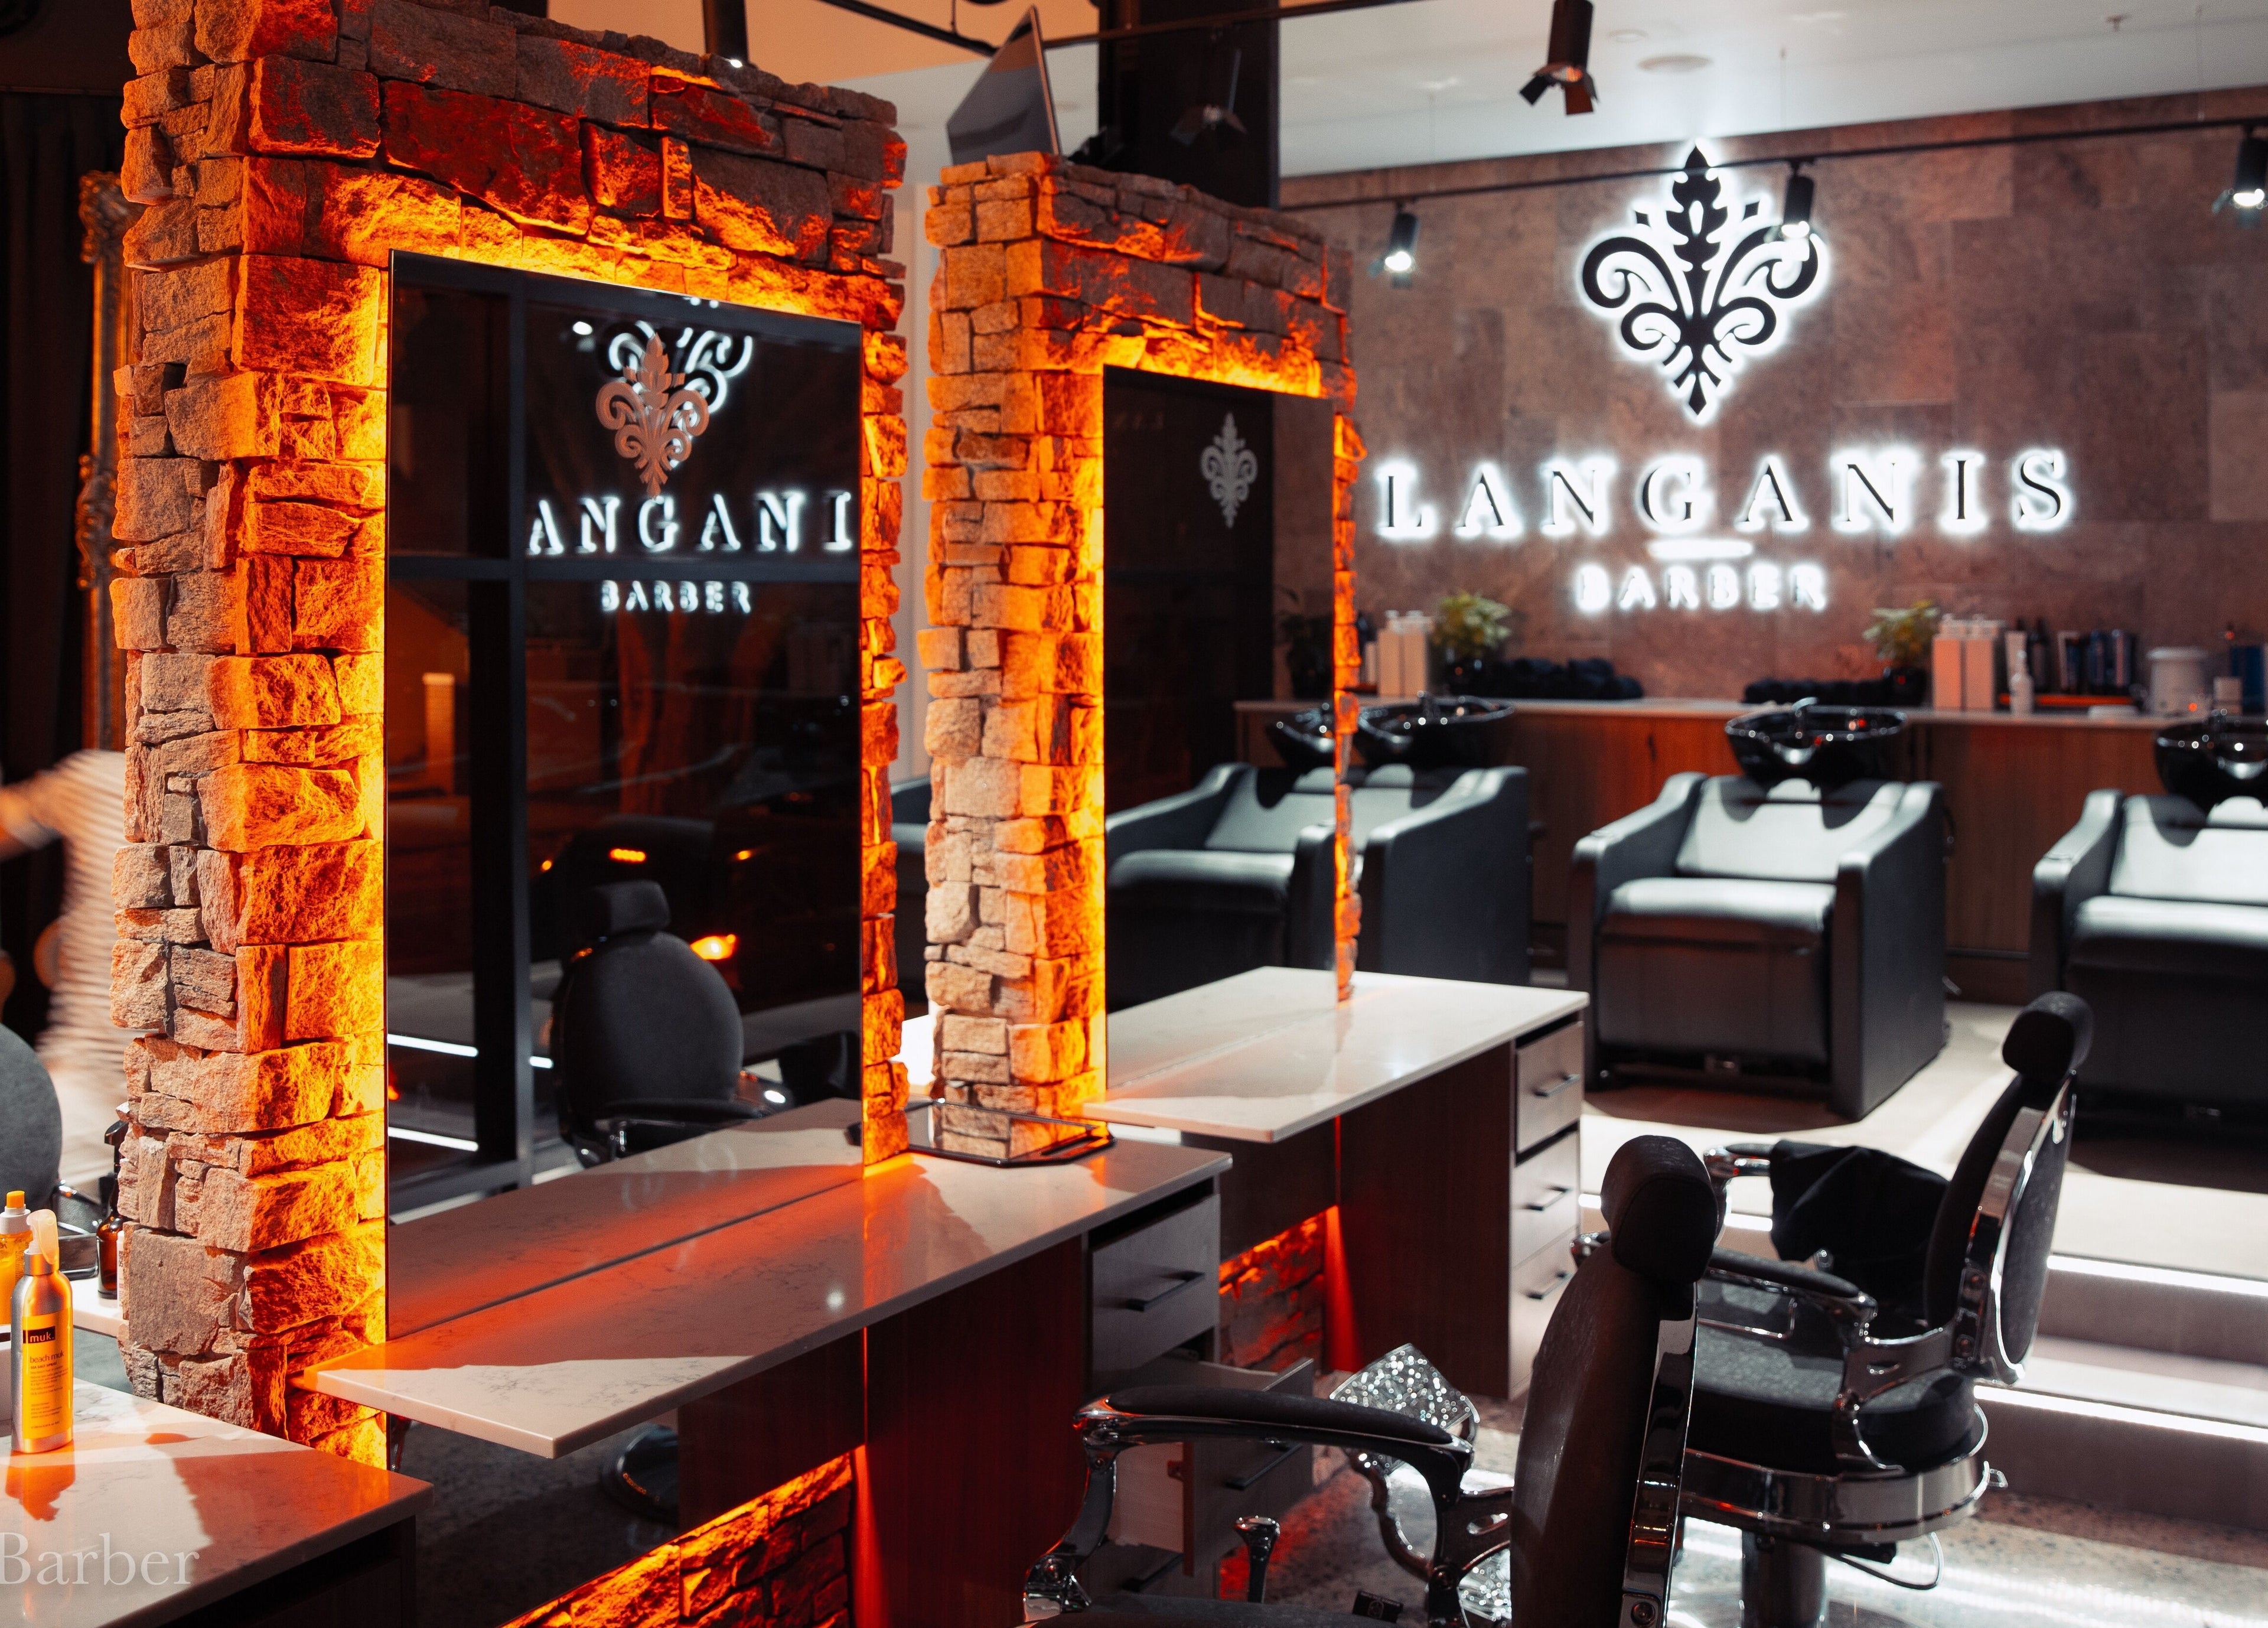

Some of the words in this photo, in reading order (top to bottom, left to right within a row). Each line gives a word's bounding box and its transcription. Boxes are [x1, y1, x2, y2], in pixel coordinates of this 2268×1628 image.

[1380, 451, 2066, 535] LANGANIS
[602, 580, 751, 613] BARBER
[1577, 565, 1826, 611] BARBER
[30, 1331, 54, 1343] muk.
[30, 1355, 50, 1363] beach
[51, 1350, 64, 1360] muk
